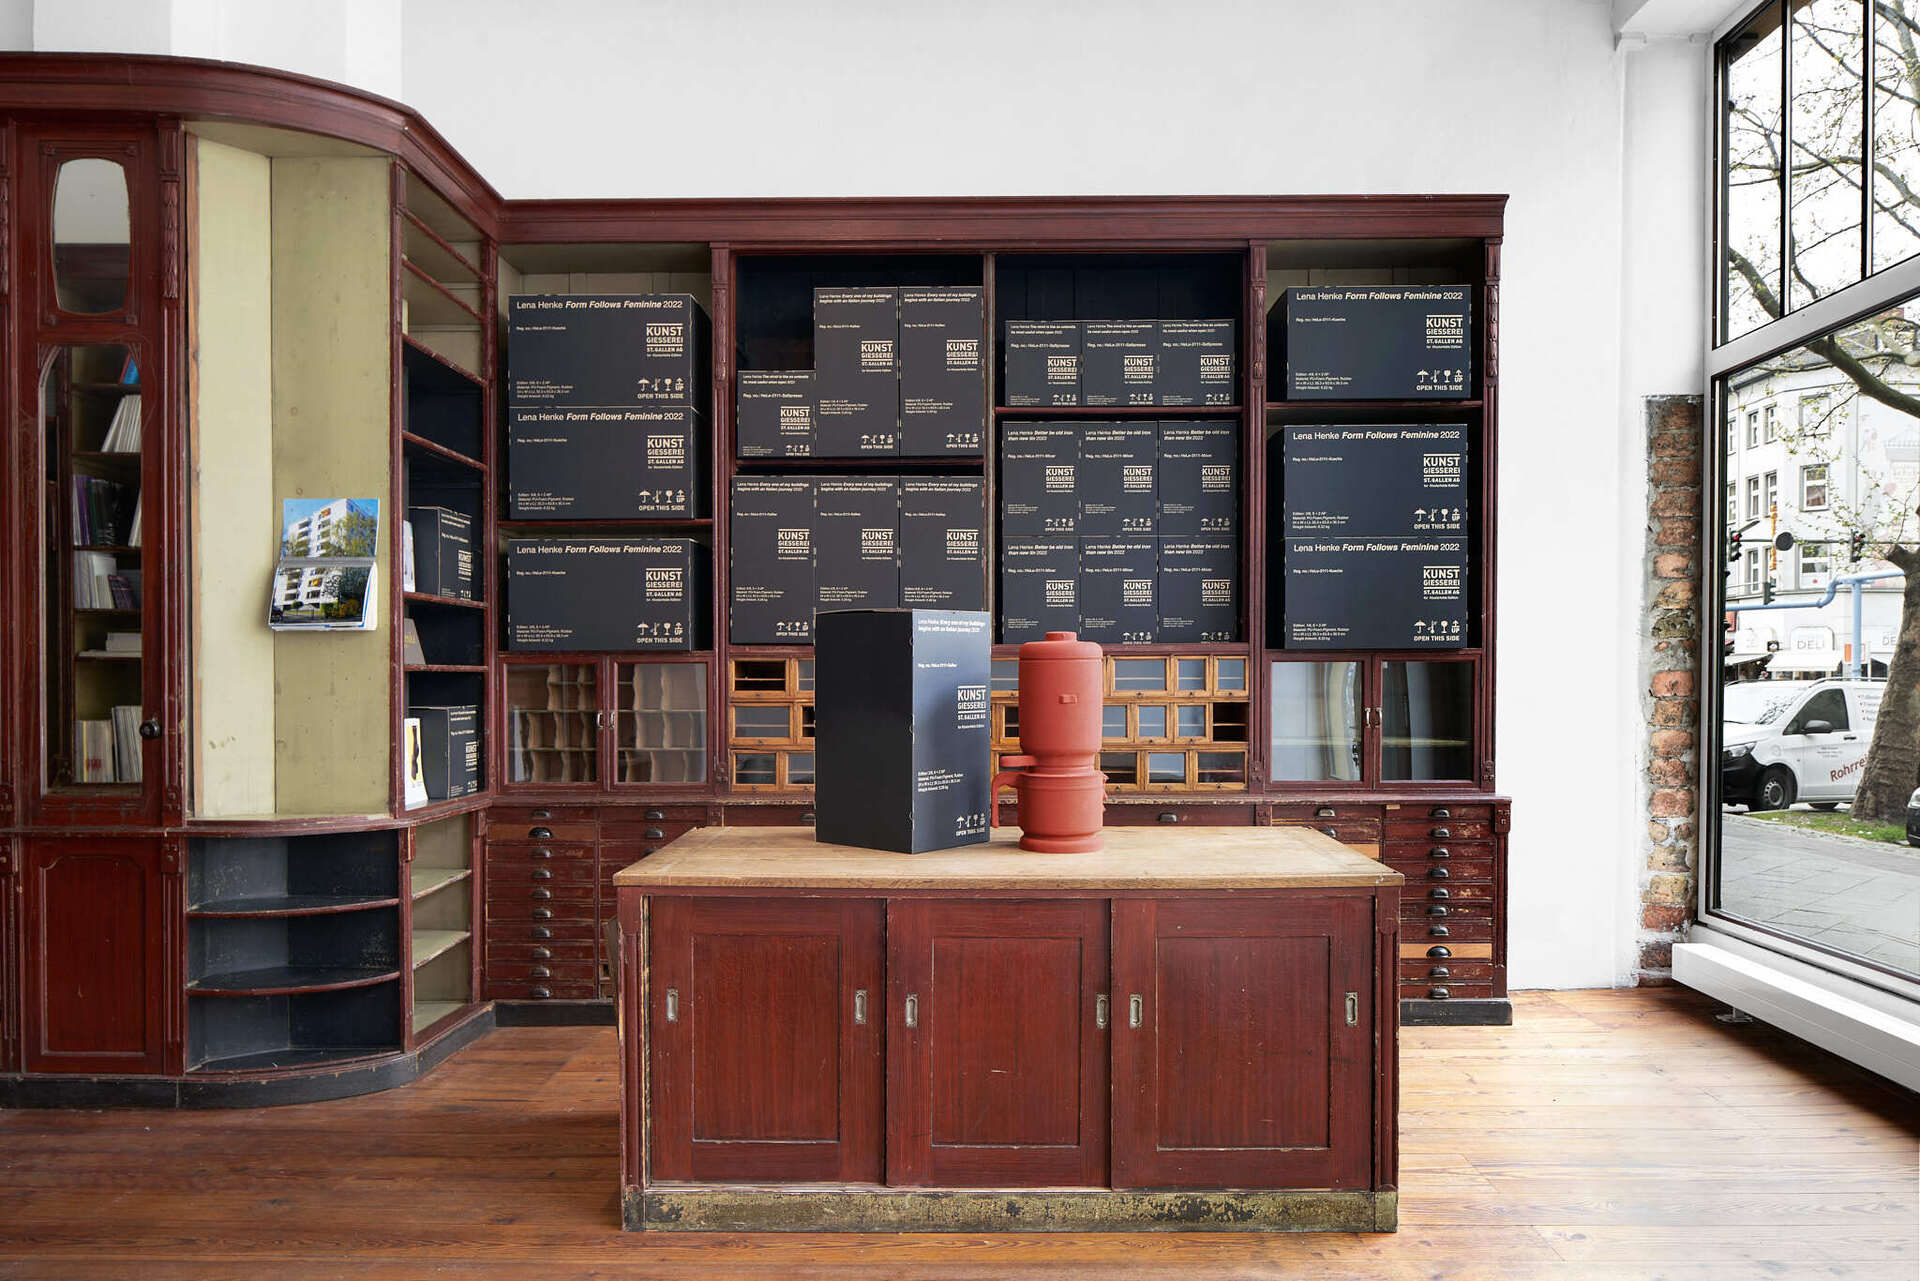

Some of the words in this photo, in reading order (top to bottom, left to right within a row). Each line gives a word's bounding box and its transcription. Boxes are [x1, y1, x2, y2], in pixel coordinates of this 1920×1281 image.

[624, 300, 662, 308] Feminine
[1426, 318, 1463, 328] KUNST
[646, 326, 683, 336] KUNST
[646, 336, 683, 345] GIESSEREI
[861, 344, 893, 352] KUNST
[946, 343, 978, 352] KUNST
[1048, 359, 1077, 368] KUNST
[566, 412, 588, 420] Form
[624, 412, 663, 420] Feminine
[664, 412, 684, 420] 2022
[780, 409, 810, 418] KUNST
[648, 439, 684, 448] KUNST
[1424, 457, 1460, 466] KUNST
[1046, 468, 1074, 477] KUNST
[778, 532, 810, 541] KUNST
[862, 532, 893, 541] KUNST
[946, 532, 978, 542] KUNST
[1294, 544, 1313, 552] Lena
[646, 571, 682, 580] KUNST
[1424, 569, 1460, 578] KUNST
[1124, 582, 1152, 591] KUNST
[1797, 640, 1825, 650] DELI
[1882, 635, 1897, 646] DE
[958, 689, 986, 701] KUNST
[958, 701, 986, 710] GIESSEREI
